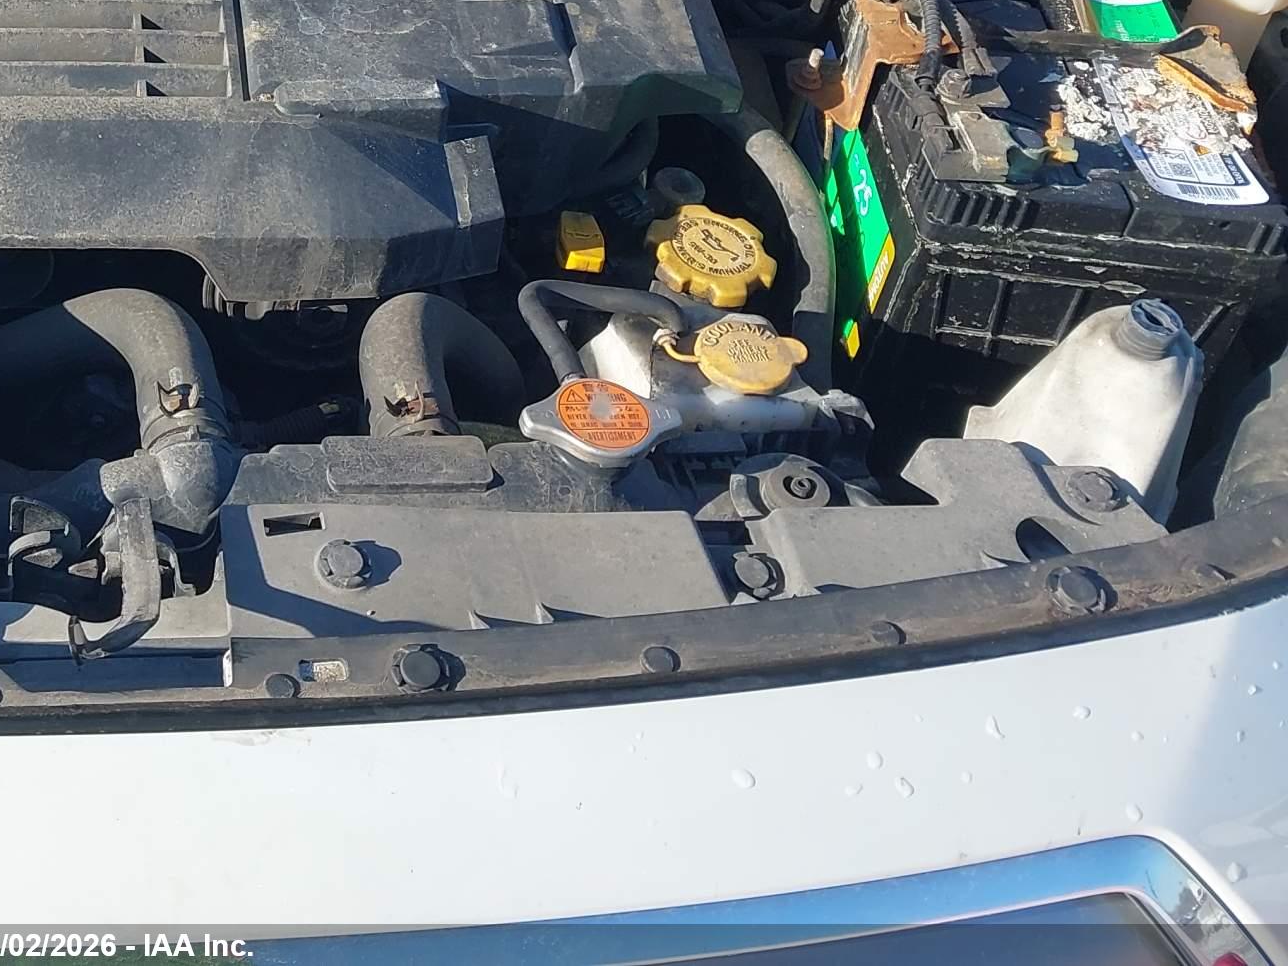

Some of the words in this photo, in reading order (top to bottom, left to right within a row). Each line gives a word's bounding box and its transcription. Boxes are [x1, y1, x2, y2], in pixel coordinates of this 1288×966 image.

[680, 219, 700, 233] SEE
[708, 261, 752, 276] MANUAL
[703, 219, 748, 244] ENGINE
[743, 241, 755, 259] OIL
[702, 321, 777, 347] COOLANT
[728, 338, 751, 347] SEE
[731, 353, 771, 364] MANUAL
[584, 393, 627, 403] WING
